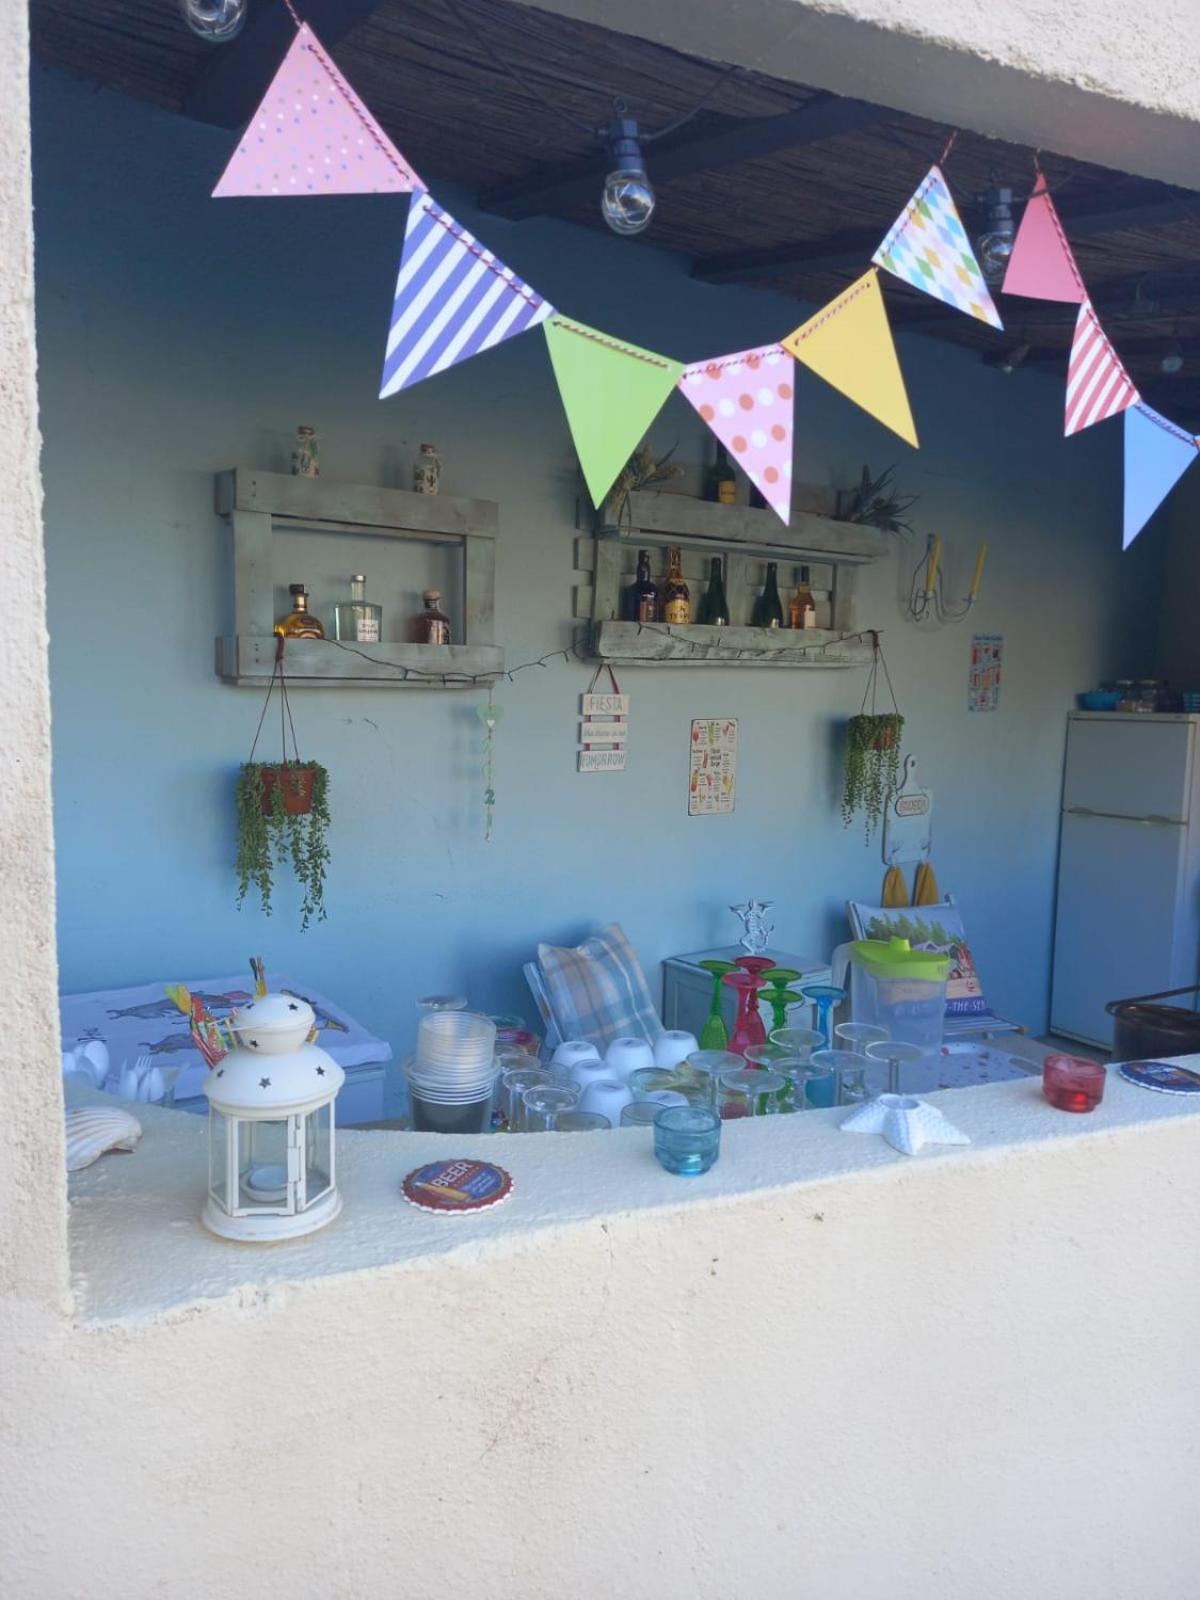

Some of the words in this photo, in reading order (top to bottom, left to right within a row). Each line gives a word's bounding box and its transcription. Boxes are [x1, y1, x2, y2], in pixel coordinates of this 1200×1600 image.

[590, 696, 623, 713] FIESTA
[581, 752, 625, 769] TOMORROW
[431, 1161, 474, 1187] BEER
